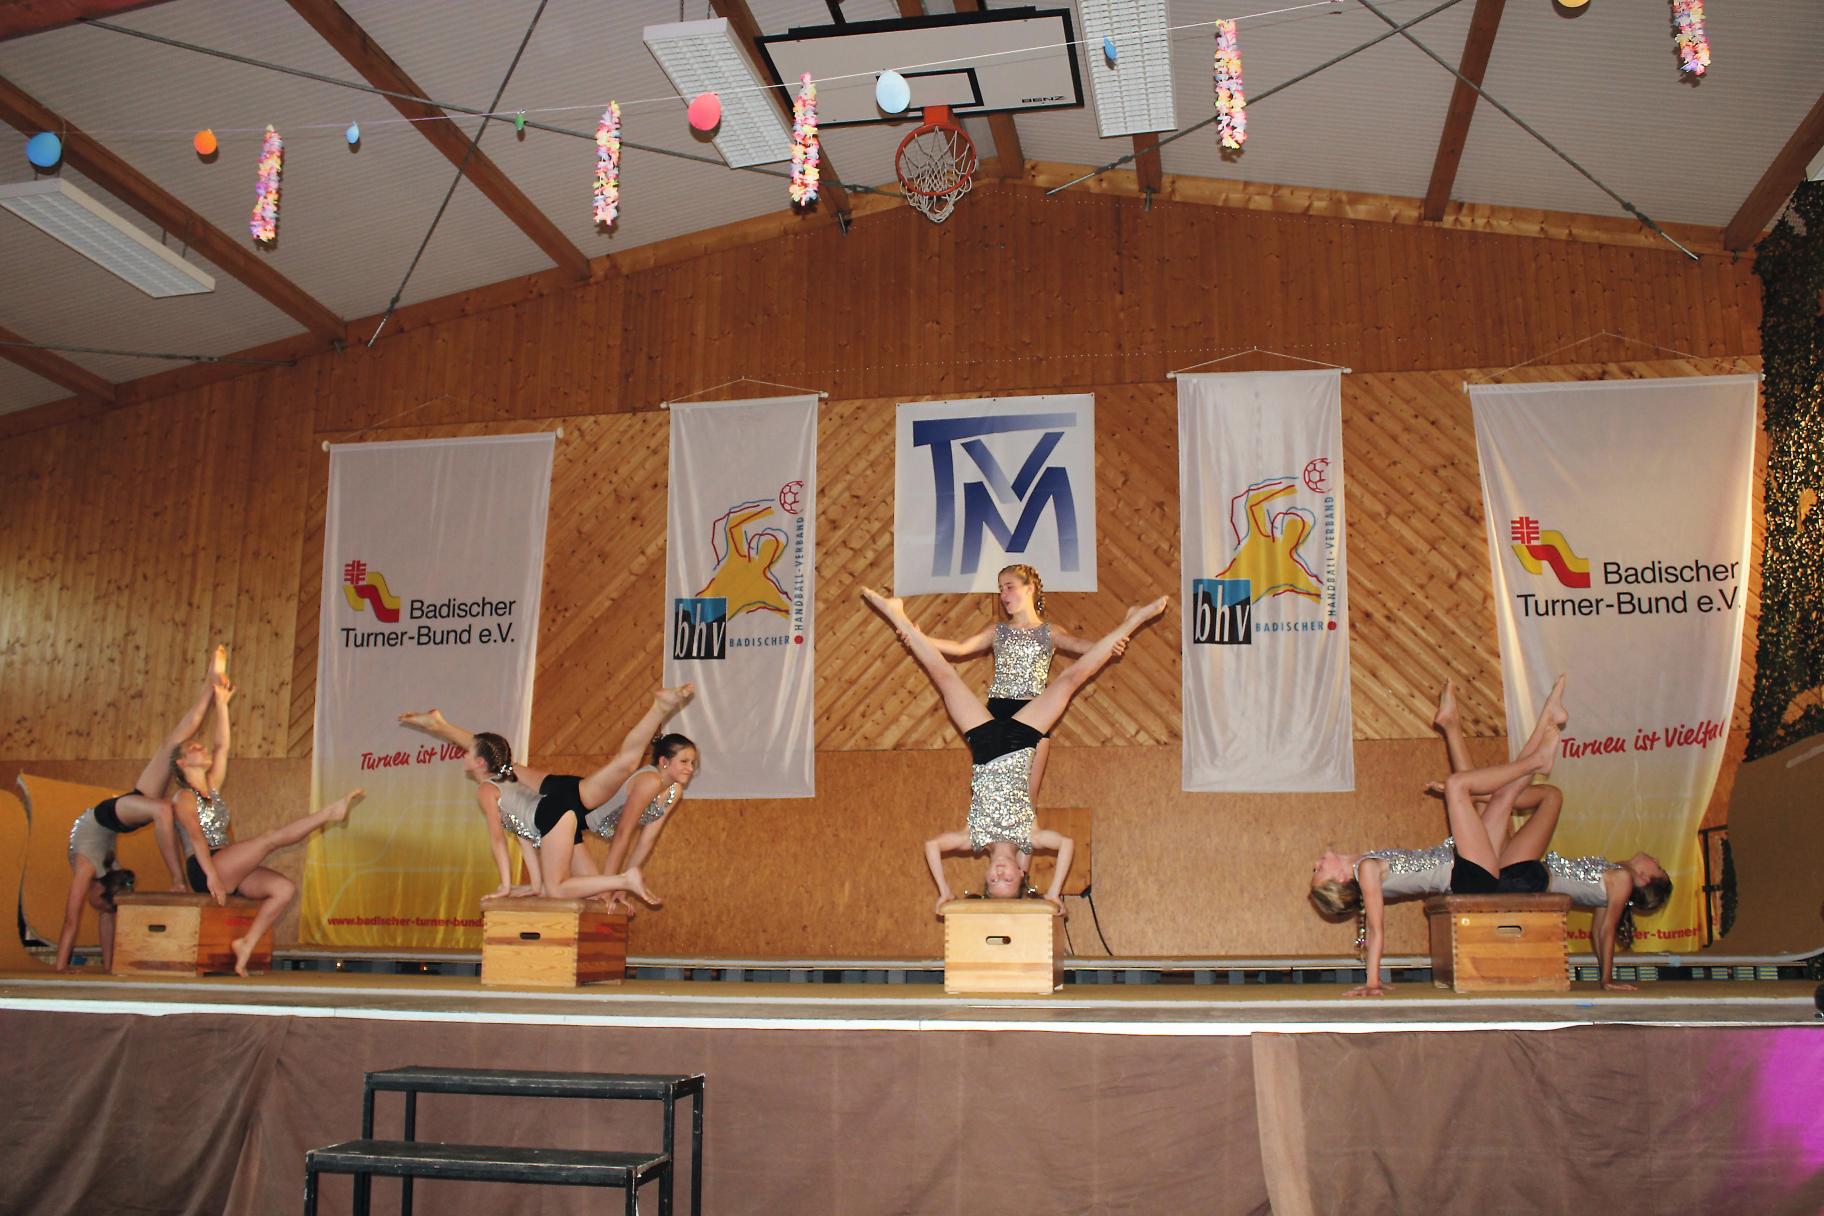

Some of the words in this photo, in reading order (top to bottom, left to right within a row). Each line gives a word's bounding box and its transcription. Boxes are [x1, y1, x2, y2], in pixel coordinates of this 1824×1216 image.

[1022, 95, 1064, 103] BENZ
[1324, 496, 1336, 617] HANDBALL-VERBAND
[793, 516, 804, 631] HANDBALL-VERBAND
[1603, 560, 1739, 585] Badischer
[409, 597, 516, 620] Badischer
[1194, 583, 1250, 642] bhv
[1517, 591, 1688, 617] Turner-Bund
[1697, 586, 1742, 613] e.V.
[341, 623, 471, 648] Turner-Bund
[479, 622, 515, 645] e.V.
[674, 603, 725, 657] bhv
[1255, 620, 1324, 633] BADISCHER
[729, 635, 790, 648] BADISCHER
[1561, 736, 1626, 759] Turnen
[1634, 728, 1661, 751] ist
[1664, 719, 1726, 749] Vielfal
[360, 752, 410, 770] Turnen
[416, 744, 437, 764] ist
[327, 915, 484, 928] www.badischer-turner-bund.
